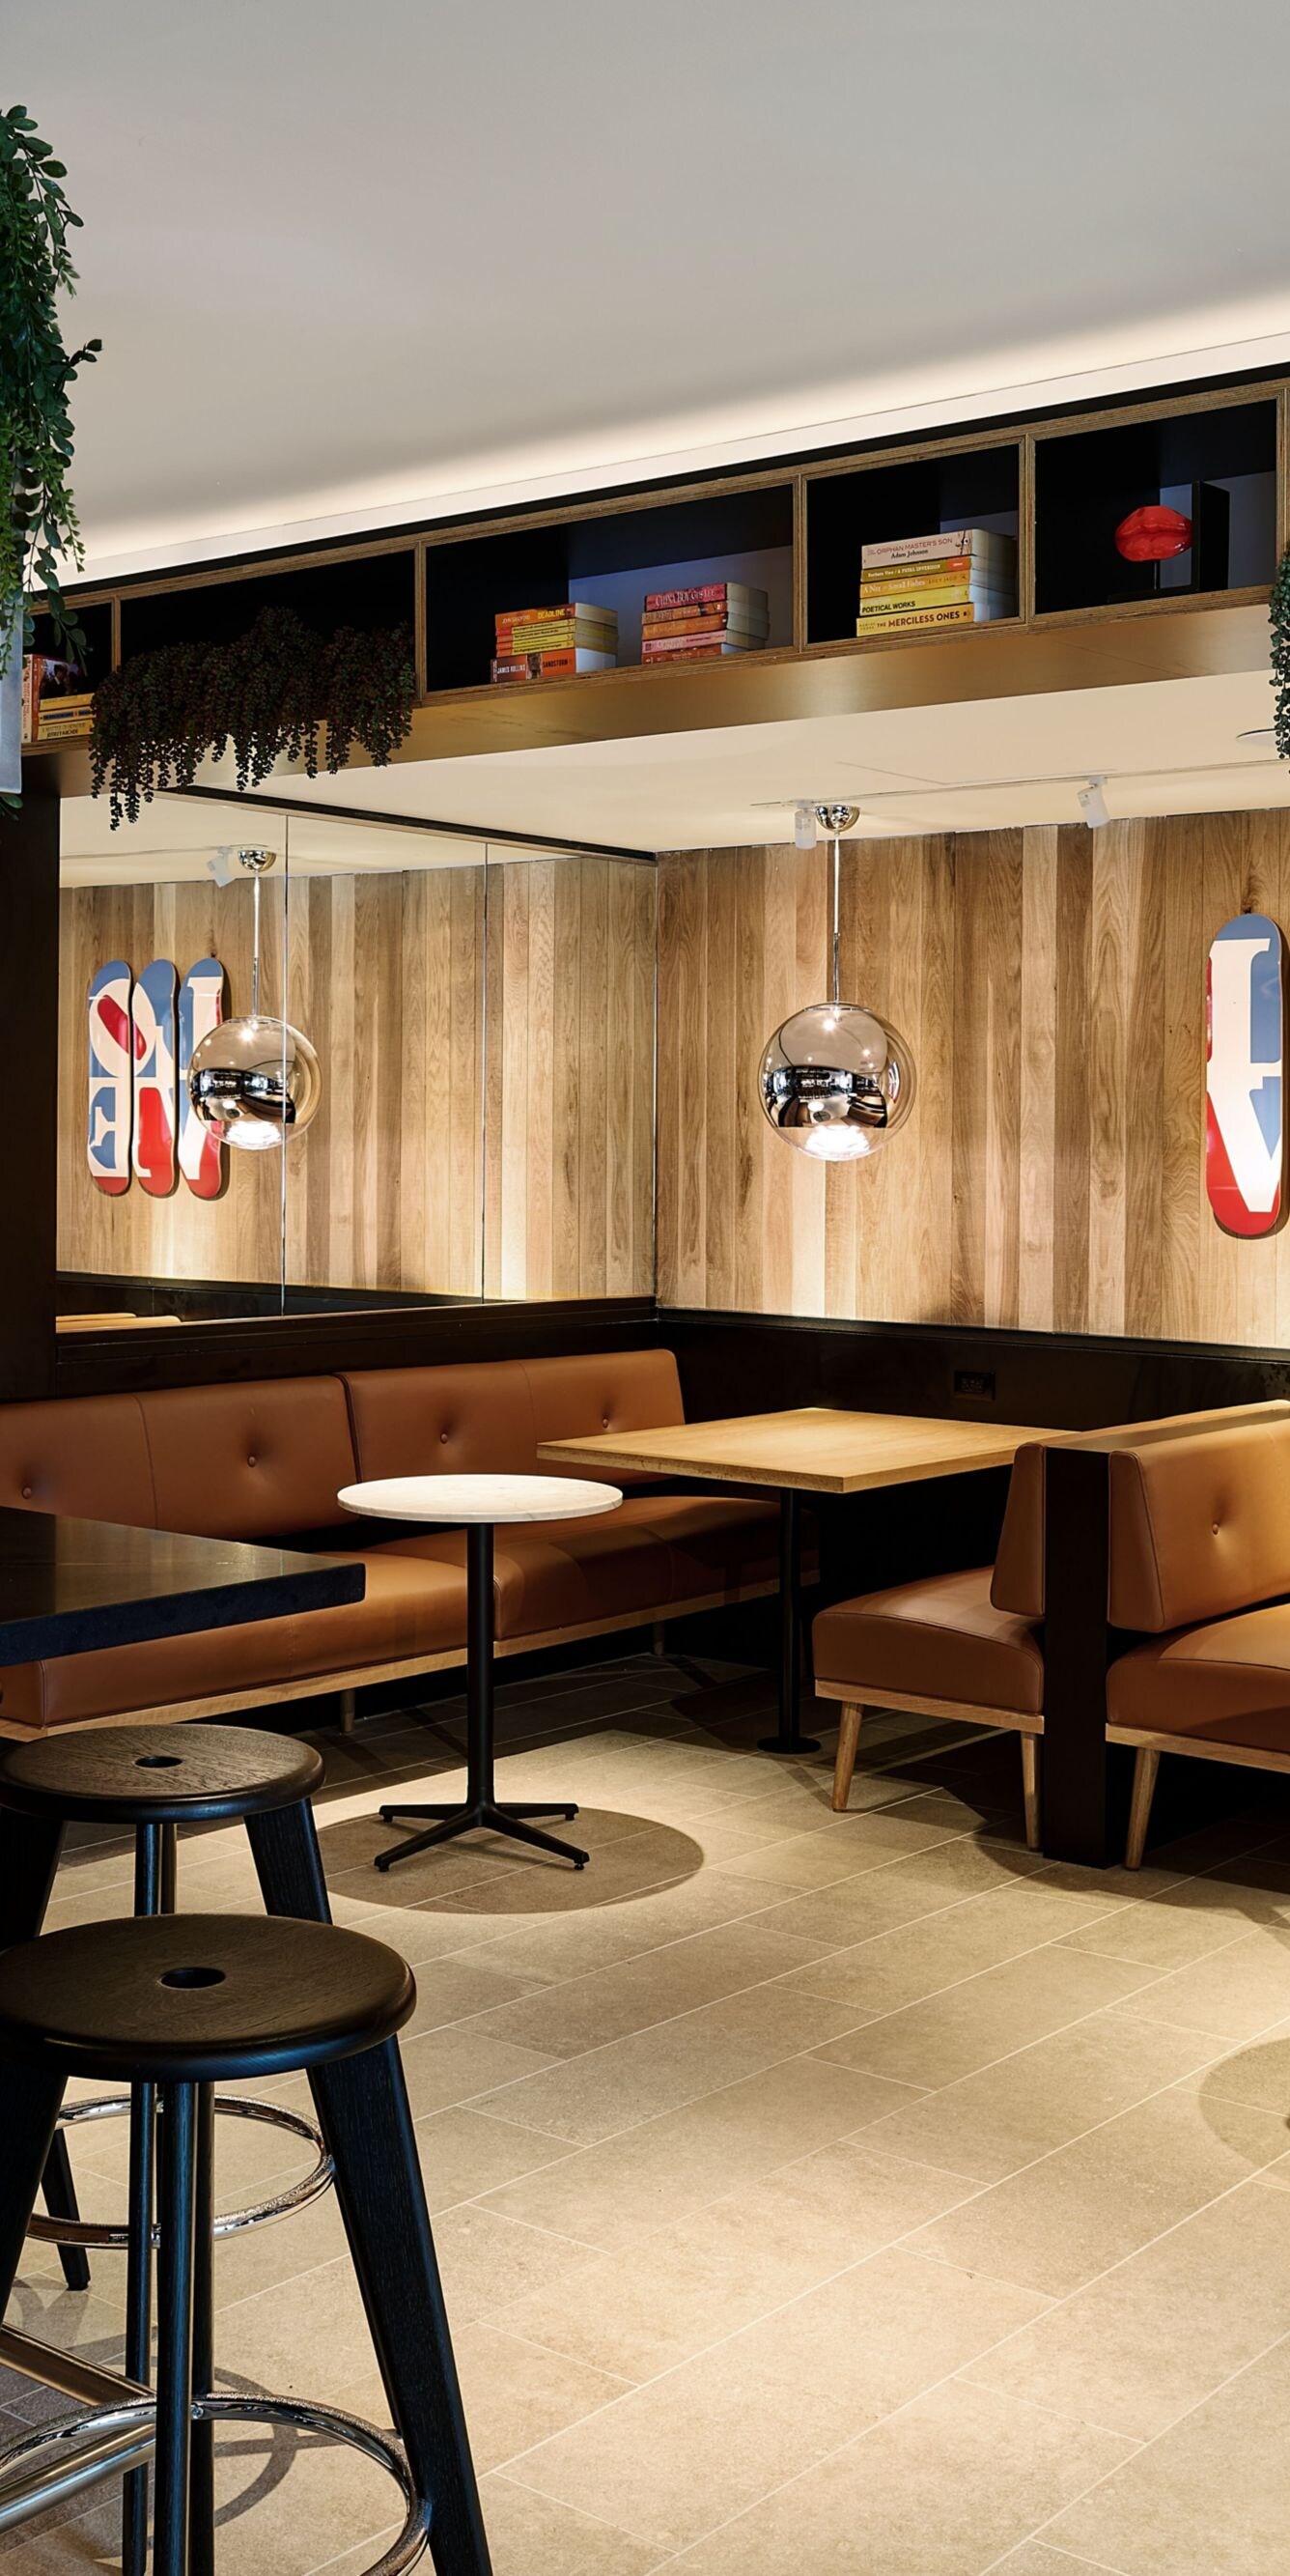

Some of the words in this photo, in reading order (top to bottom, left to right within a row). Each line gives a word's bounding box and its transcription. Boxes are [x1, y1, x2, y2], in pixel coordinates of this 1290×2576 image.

[877, 545, 904, 554] ORPHAN
[861, 604, 892, 613] POETICAL
[892, 601, 915, 610] WORKS
[887, 615, 934, 628] MERCILESS
[936, 610, 960, 621] ONES
